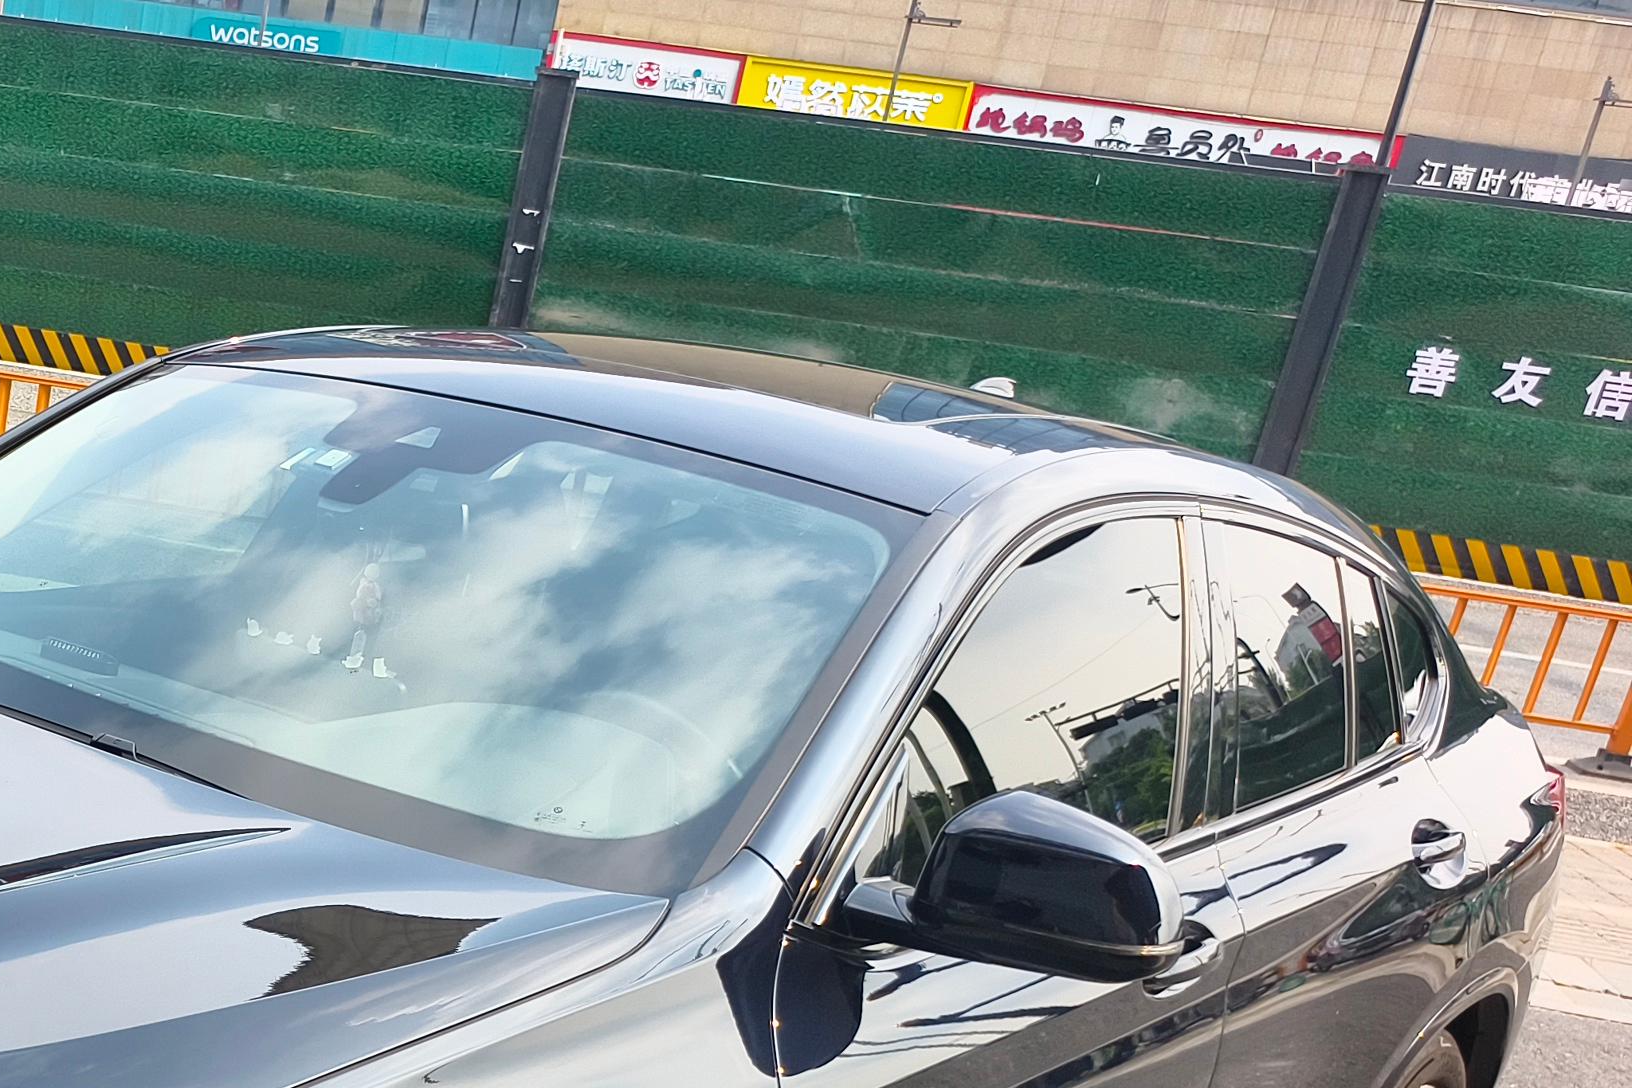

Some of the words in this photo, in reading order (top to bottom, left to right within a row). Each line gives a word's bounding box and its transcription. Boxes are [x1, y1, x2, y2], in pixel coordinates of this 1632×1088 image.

[210, 24, 320, 53] watsons
[1406, 346, 1632, 421] 善友信
